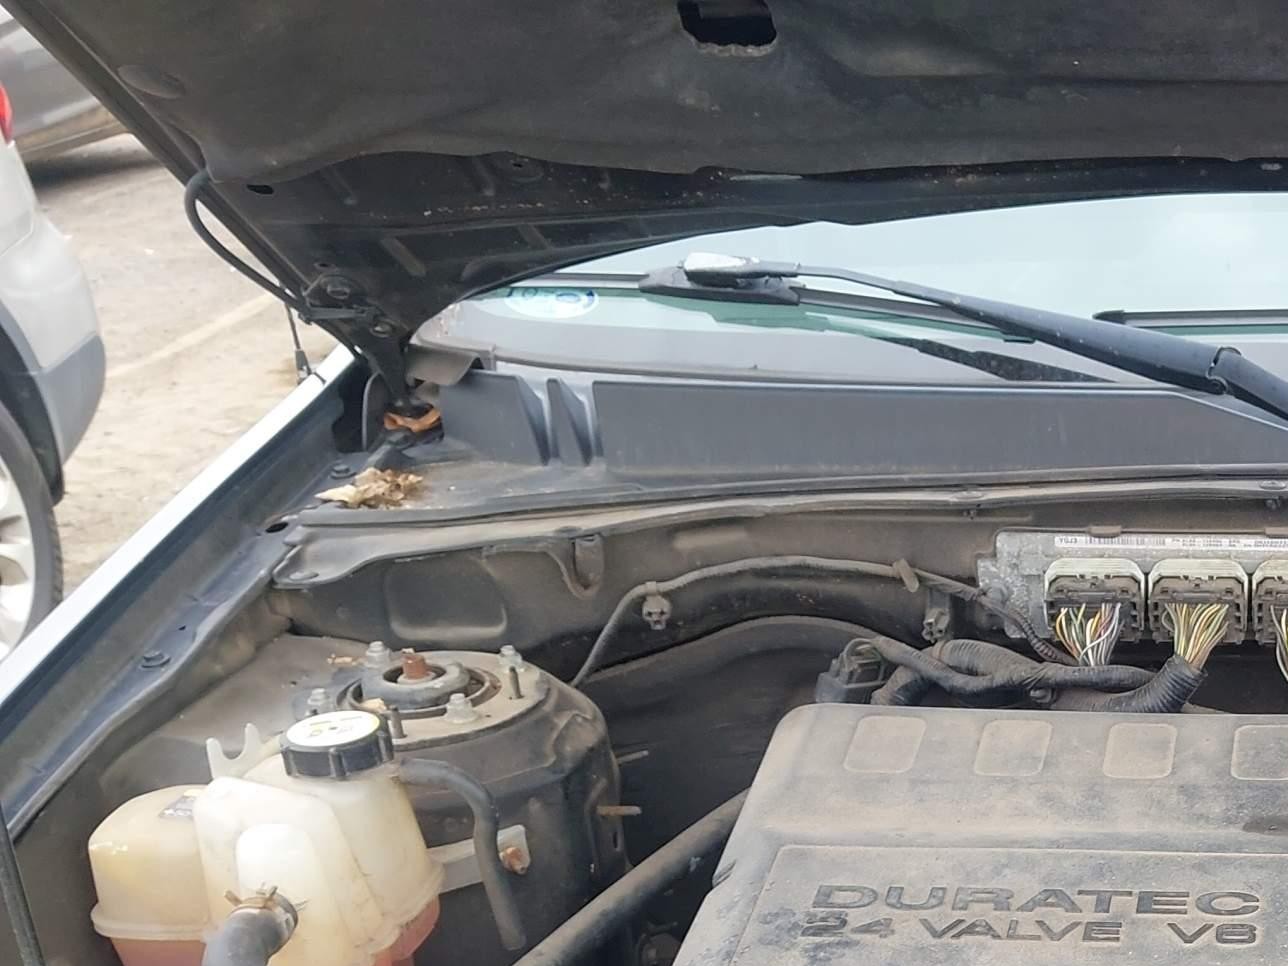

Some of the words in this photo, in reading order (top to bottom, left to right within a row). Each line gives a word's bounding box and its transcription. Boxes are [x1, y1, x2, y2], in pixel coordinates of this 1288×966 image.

[812, 885, 1260, 917] DURATEC
[800, 910, 895, 939] 24
[919, 918, 1124, 943] VALVE
[1167, 922, 1257, 945] V6
